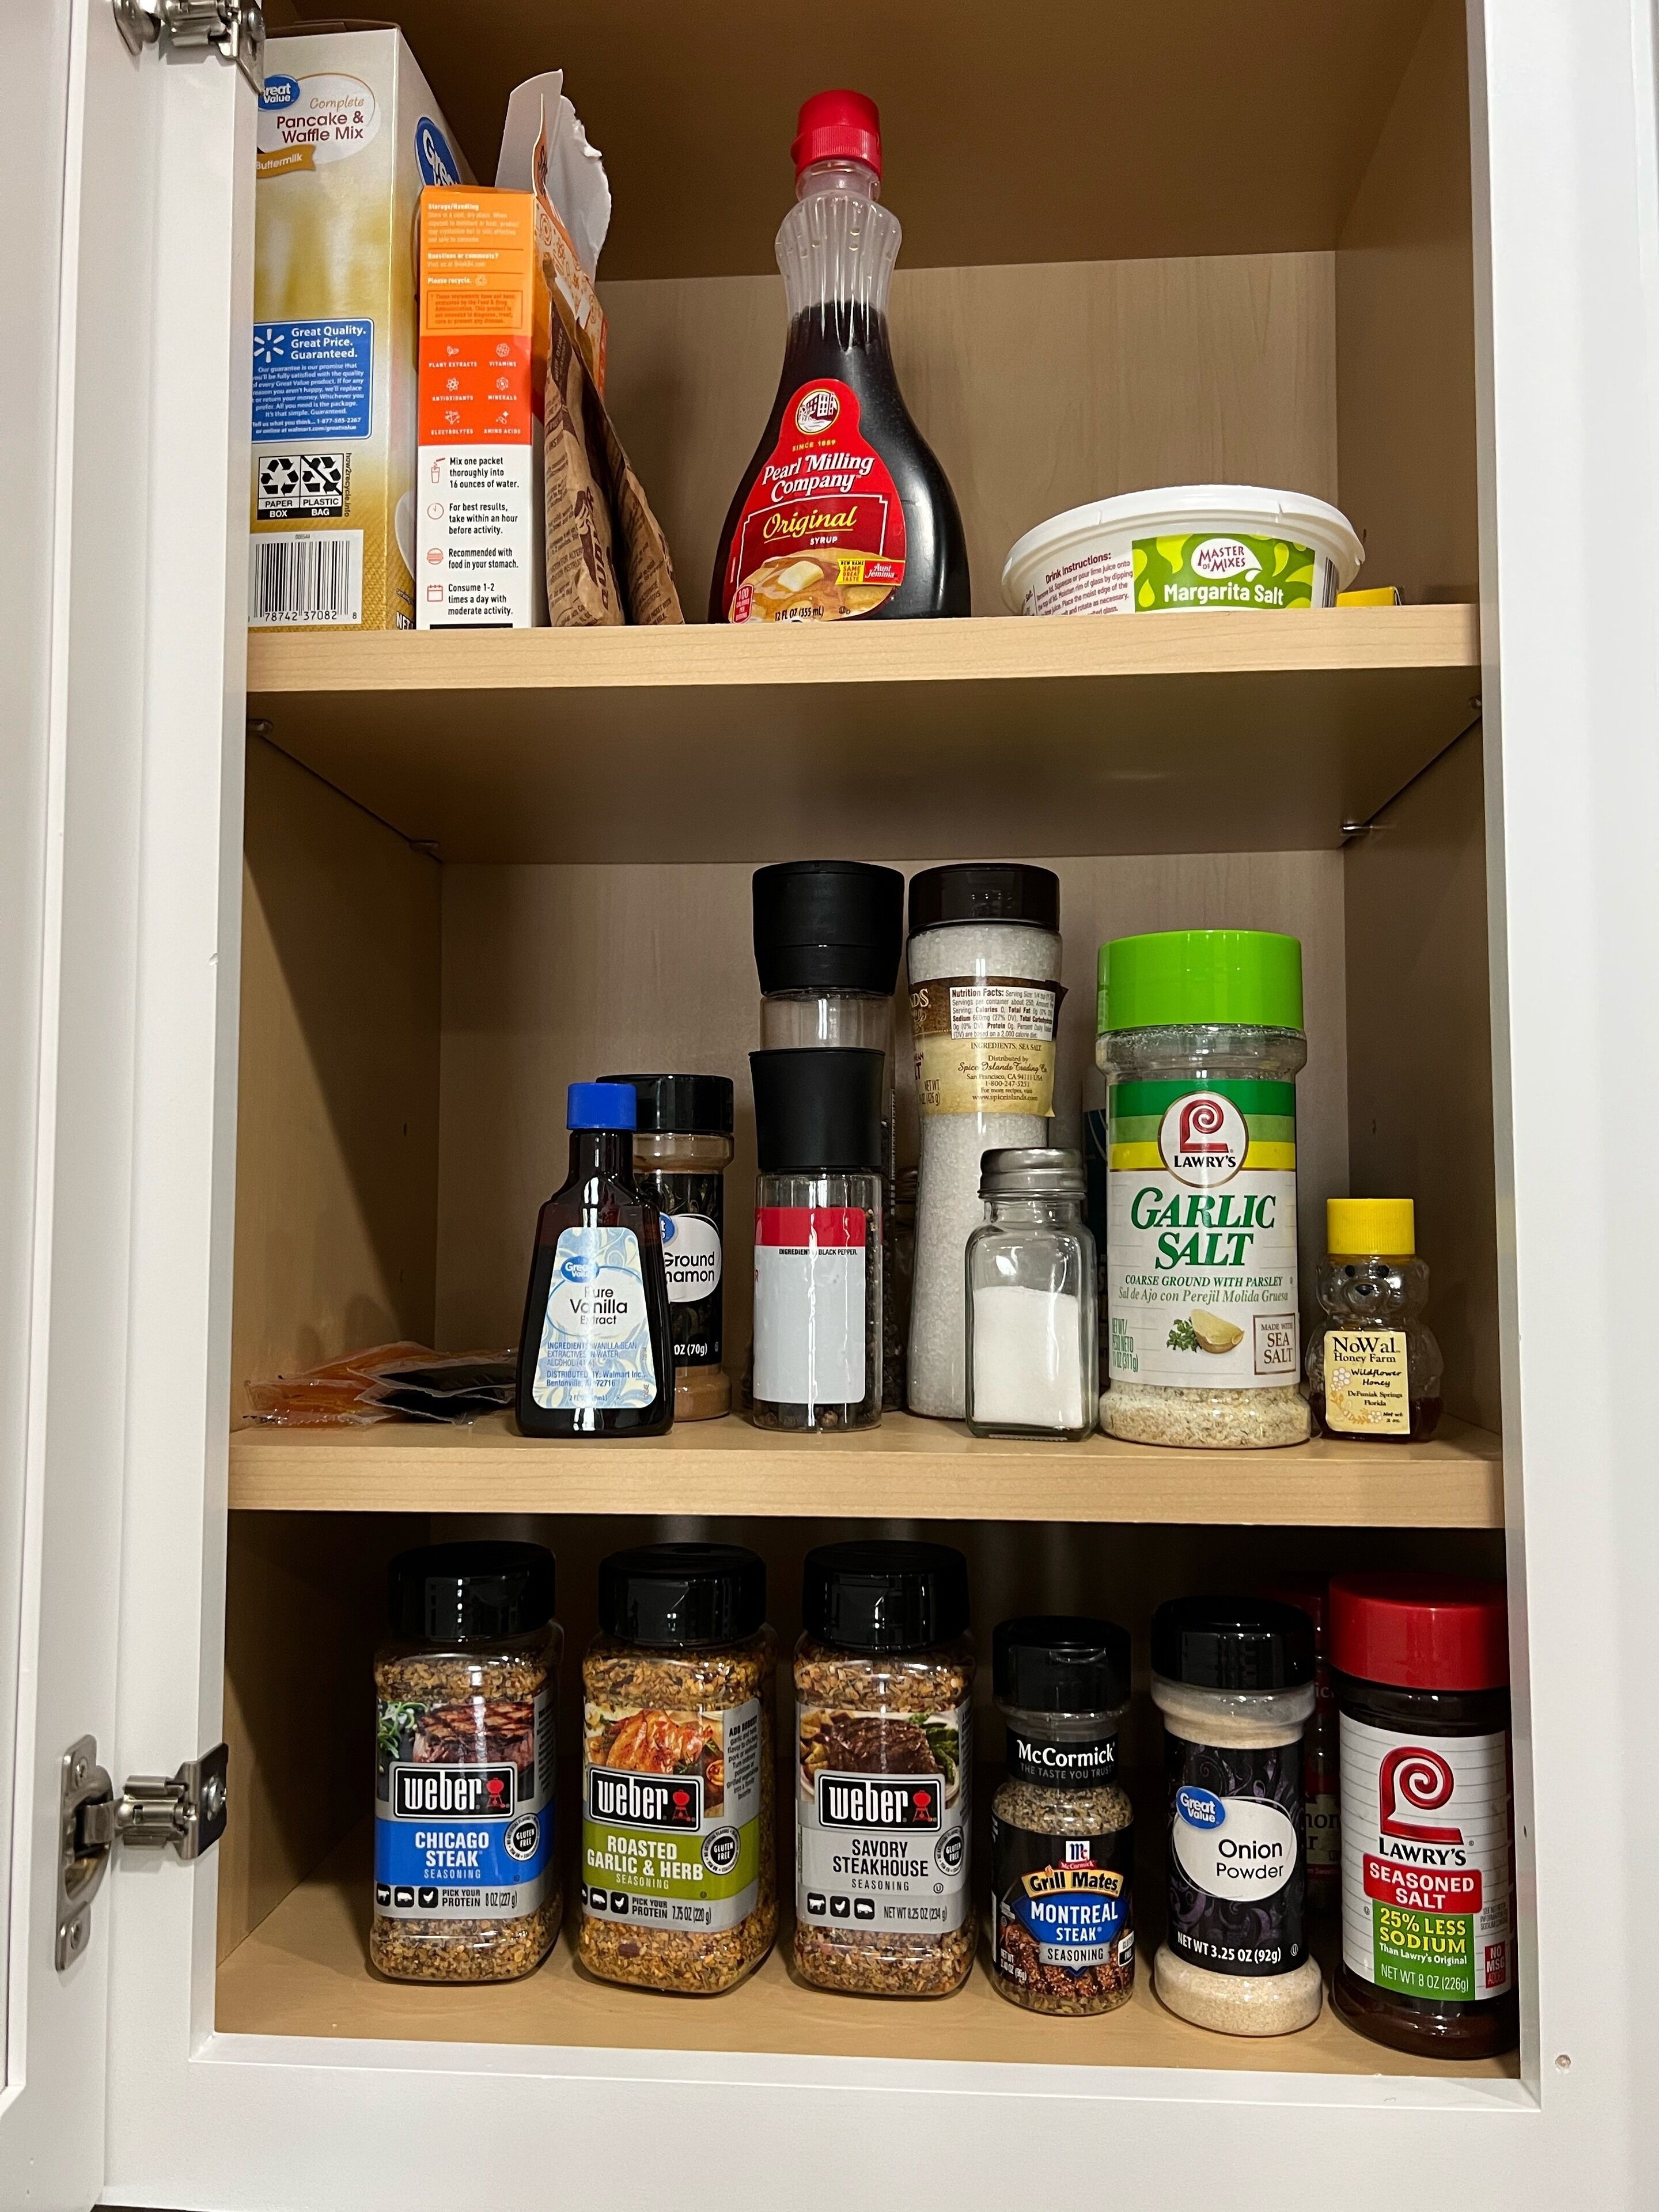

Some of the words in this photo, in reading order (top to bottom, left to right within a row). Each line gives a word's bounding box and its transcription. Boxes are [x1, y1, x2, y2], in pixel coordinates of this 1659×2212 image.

[310, 96, 364, 112] Complete
[276, 113, 347, 129] Pancake
[353, 111, 364, 123] &
[282, 128, 329, 143] Waffle
[335, 127, 364, 141] Mix
[291, 327, 321, 337] Great
[324, 325, 366, 336] Quality.
[291, 338, 321, 349] Great
[324, 338, 353, 347] Price.
[291, 348, 358, 360] Guaranteed.
[792, 442, 814, 452] SINCE
[479, 457, 503, 466] packet
[762, 457, 802, 486] Pearl
[806, 453, 875, 474] Milling
[450, 469, 488, 478] thoroughly
[344, 453, 352, 517] how2recycle.info
[771, 474, 857, 503] Company
[463, 503, 478, 511] best
[480, 503, 508, 512] results,
[474, 527, 503, 535] activity.
[763, 506, 857, 540] Original
[810, 536, 838, 546] SYRUP
[449, 548, 497, 556] Recommended
[1198, 547, 1245, 565] MASTER
[449, 560, 463, 569] food
[472, 562, 486, 570] your
[864, 569, 895, 578] Jemima
[873, 563, 892, 571] Aunt
[1046, 569, 1061, 584] Drink
[1062, 552, 1111, 575] Instructions:
[1210, 558, 1246, 573] MIXES
[1164, 583, 1251, 604] Margarita
[1254, 584, 1284, 607] Salt
[265, 612, 297, 622] 78742
[304, 610, 337, 620] 37082
[952, 989, 981, 997] Nutrition
[1174, 1154, 1236, 1169] LAWRY'S
[1131, 1187, 1276, 1230] GARLIC
[664, 1251, 715, 1267] Ground
[1155, 1232, 1253, 1270] SALT
[1125, 1274, 1160, 1287] COARSE
[1162, 1275, 1210, 1287] GROUND
[1214, 1277, 1244, 1287] WITH
[1245, 1276, 1283, 1287] PARSLEY
[1118, 1286, 1131, 1300] Sal
[1130, 1287, 1142, 1300] de
[1142, 1289, 1158, 1302] Ajo
[1160, 1291, 1179, 1302] con
[1181, 1289, 1219, 1305] Perejil
[1222, 1290, 1259, 1303] Molida
[1261, 1289, 1289, 1302] Gruesa
[1267, 1332, 1290, 1347] SEA
[1332, 1337, 1395, 1354] NoWal
[674, 1344, 685, 1355] OZ
[687, 1343, 707, 1356] (70g)
[1264, 1347, 1293, 1365] SALT
[1334, 1353, 1366, 1363] Honey
[1370, 1354, 1396, 1362] Farm
[1351, 1369, 1402, 1377] Wildflower
[1362, 1379, 1390, 1387] Honey
[1017, 1740, 1114, 1768] McCormick
[1020, 1763, 1035, 1775] THE
[1037, 1767, 1066, 1779] TASTE
[1069, 1769, 1089, 1779] YOU
[1090, 1765, 1112, 1777] TRUST
[404, 1770, 482, 1810] weber
[597, 1777, 668, 1820] weber
[829, 1782, 908, 1823] weber
[1180, 1793, 1215, 1815] Great
[1187, 1806, 1215, 1823] Value
[415, 1832, 489, 1850] CHICAGO
[608, 1835, 677, 1860] ROASTED
[852, 1839, 908, 1858] SAVORY
[1218, 1838, 1283, 1859] Onion
[426, 1850, 479, 1867] STEAK
[1379, 1836, 1467, 1866] LAWRY'S
[424, 1869, 481, 1878] SEASONING
[587, 1850, 638, 1874] GARLIC
[642, 1861, 654, 1876] &
[660, 1862, 703, 1881] HERB
[833, 1855, 929, 1877] STEAKHOUSE
[1217, 1862, 1284, 1880] Powder
[616, 1873, 669, 1890] SEASONING
[851, 1878, 910, 1891] SEASONING
[1029, 1872, 1066, 1892] Grill
[1072, 1871, 1118, 1892] Mates
[1370, 1863, 1474, 1893] SEASONED
[442, 1889, 459, 1897] PICK
[461, 1889, 480, 1897] YOUR
[1396, 1888, 1445, 1909] SALT
[442, 1897, 480, 1907] PROTEIN
[632, 1897, 647, 1907] PICK
[650, 1899, 667, 1909] YOUR
[632, 1905, 668, 1919] PROTEIN
[1031, 1901, 1118, 1925] MONTREAL
[1380, 1907, 1420, 1933] 25%
[1424, 1918, 1466, 1936] LESS
[1056, 1927, 1096, 1941] STEAK
[1380, 1927, 1466, 1954] SODIUM
[1047, 1947, 1104, 1961] SEASONING
[1177, 1931, 1192, 1948] NET
[1194, 1938, 1208, 1956] WT
[1211, 1945, 1235, 1960] 3.25
[1237, 1949, 1252, 1961] OZ
[1254, 1947, 1281, 1964] (92g)
[1379, 1942, 1399, 1956] Than
[1400, 1946, 1432, 1964] Lawry's
[1434, 1953, 1467, 1965] Original
[1381, 1964, 1397, 1980] NET
[1399, 1970, 1415, 1984] WT
[1418, 1975, 1424, 1987] 8
[1426, 1976, 1439, 1988] OZ
[1441, 1976, 1469, 1993] (226g)
